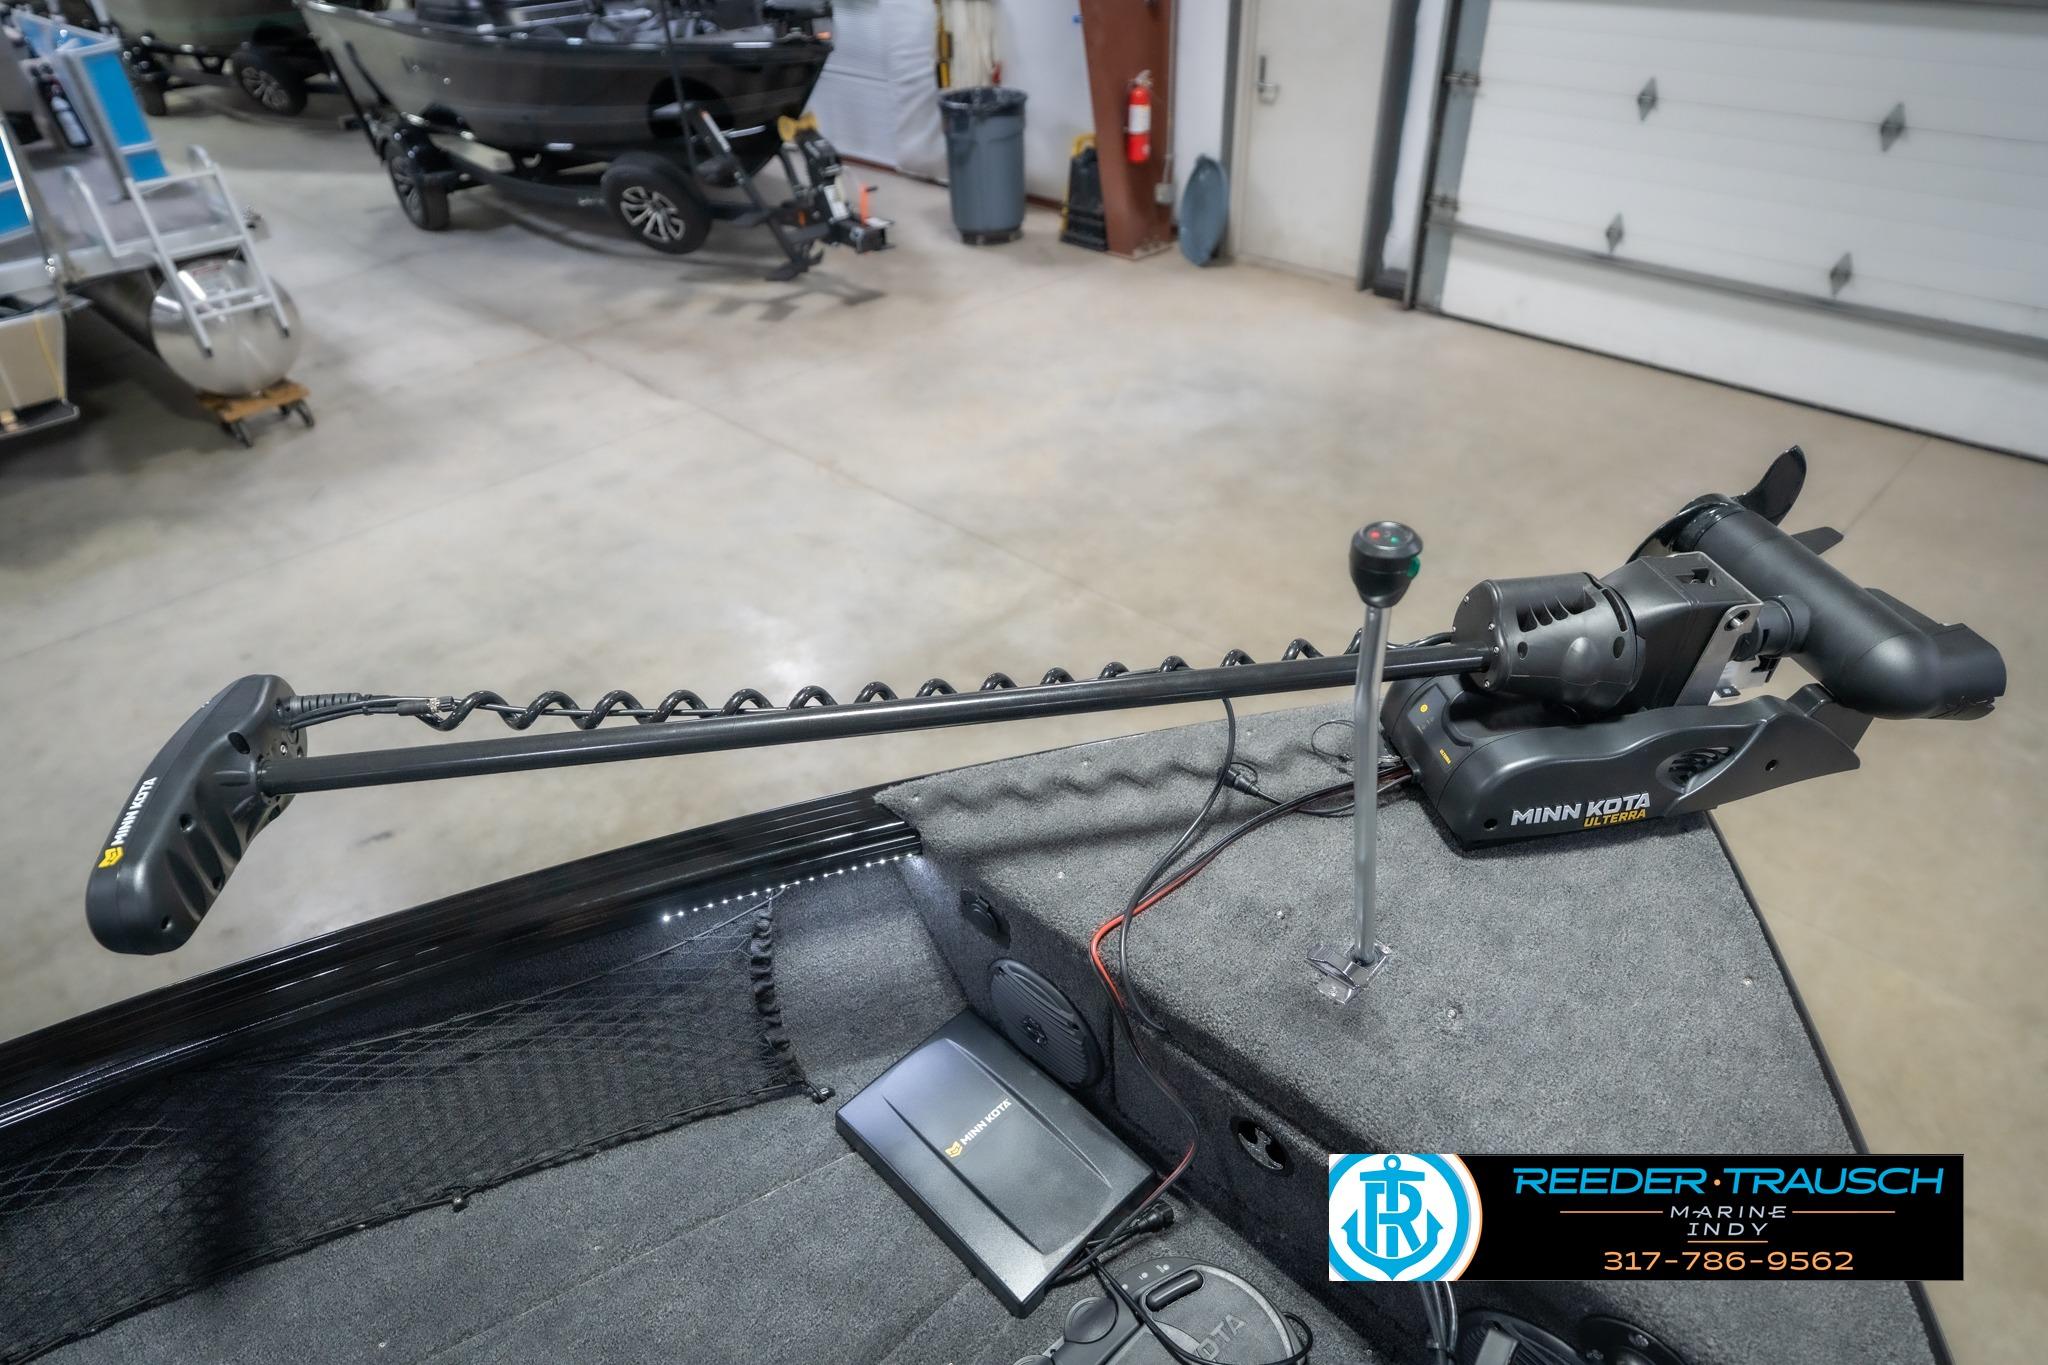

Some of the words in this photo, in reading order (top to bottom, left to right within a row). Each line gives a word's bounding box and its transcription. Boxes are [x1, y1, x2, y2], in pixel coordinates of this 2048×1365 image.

[110, 810, 140, 846] MINN
[129, 776, 158, 810] KOTA
[1510, 803, 1582, 826] MINN
[1586, 792, 1651, 818] KOTA
[1583, 809, 1647, 828] ULTERRA
[959, 1120, 988, 1146] MINN
[984, 1098, 1012, 1123] KOTA
[1196, 1314, 1246, 1363] OTA
